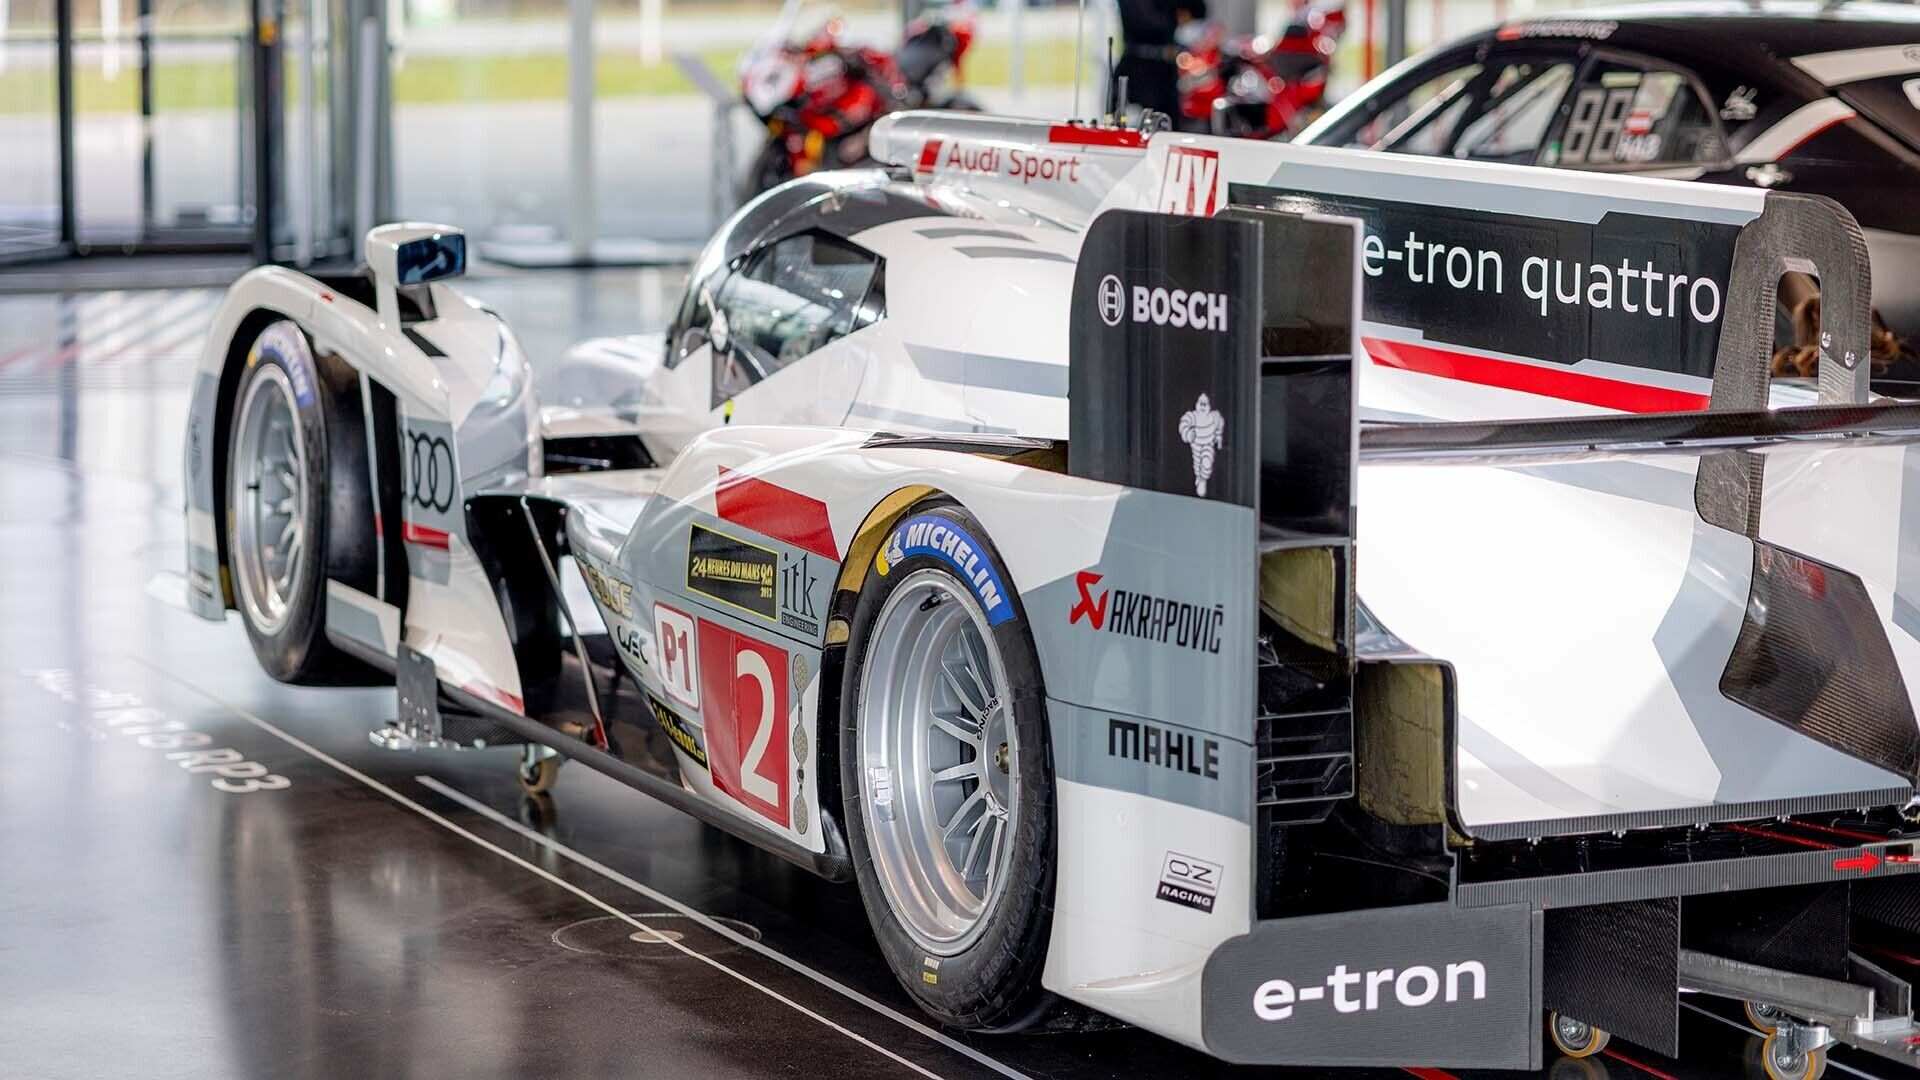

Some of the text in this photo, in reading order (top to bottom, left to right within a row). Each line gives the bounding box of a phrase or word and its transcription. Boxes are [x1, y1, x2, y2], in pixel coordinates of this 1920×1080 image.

[946, 142, 1081, 184] Audi Sport
[1362, 230, 1721, 324] e-tron quattro
[1132, 285, 1228, 332] BOSCH
[691, 556, 706, 577] 24
[781, 552, 818, 620] itk
[905, 522, 1002, 611] MICHELIN
[616, 624, 649, 665] WEC
[661, 619, 692, 693] P1
[736, 649, 779, 809] 2
[976, 697, 999, 741] RACING
[1108, 718, 1219, 781] MAHLE
[1160, 885, 1212, 907] RACING
[1252, 959, 1487, 1021] e-tron
